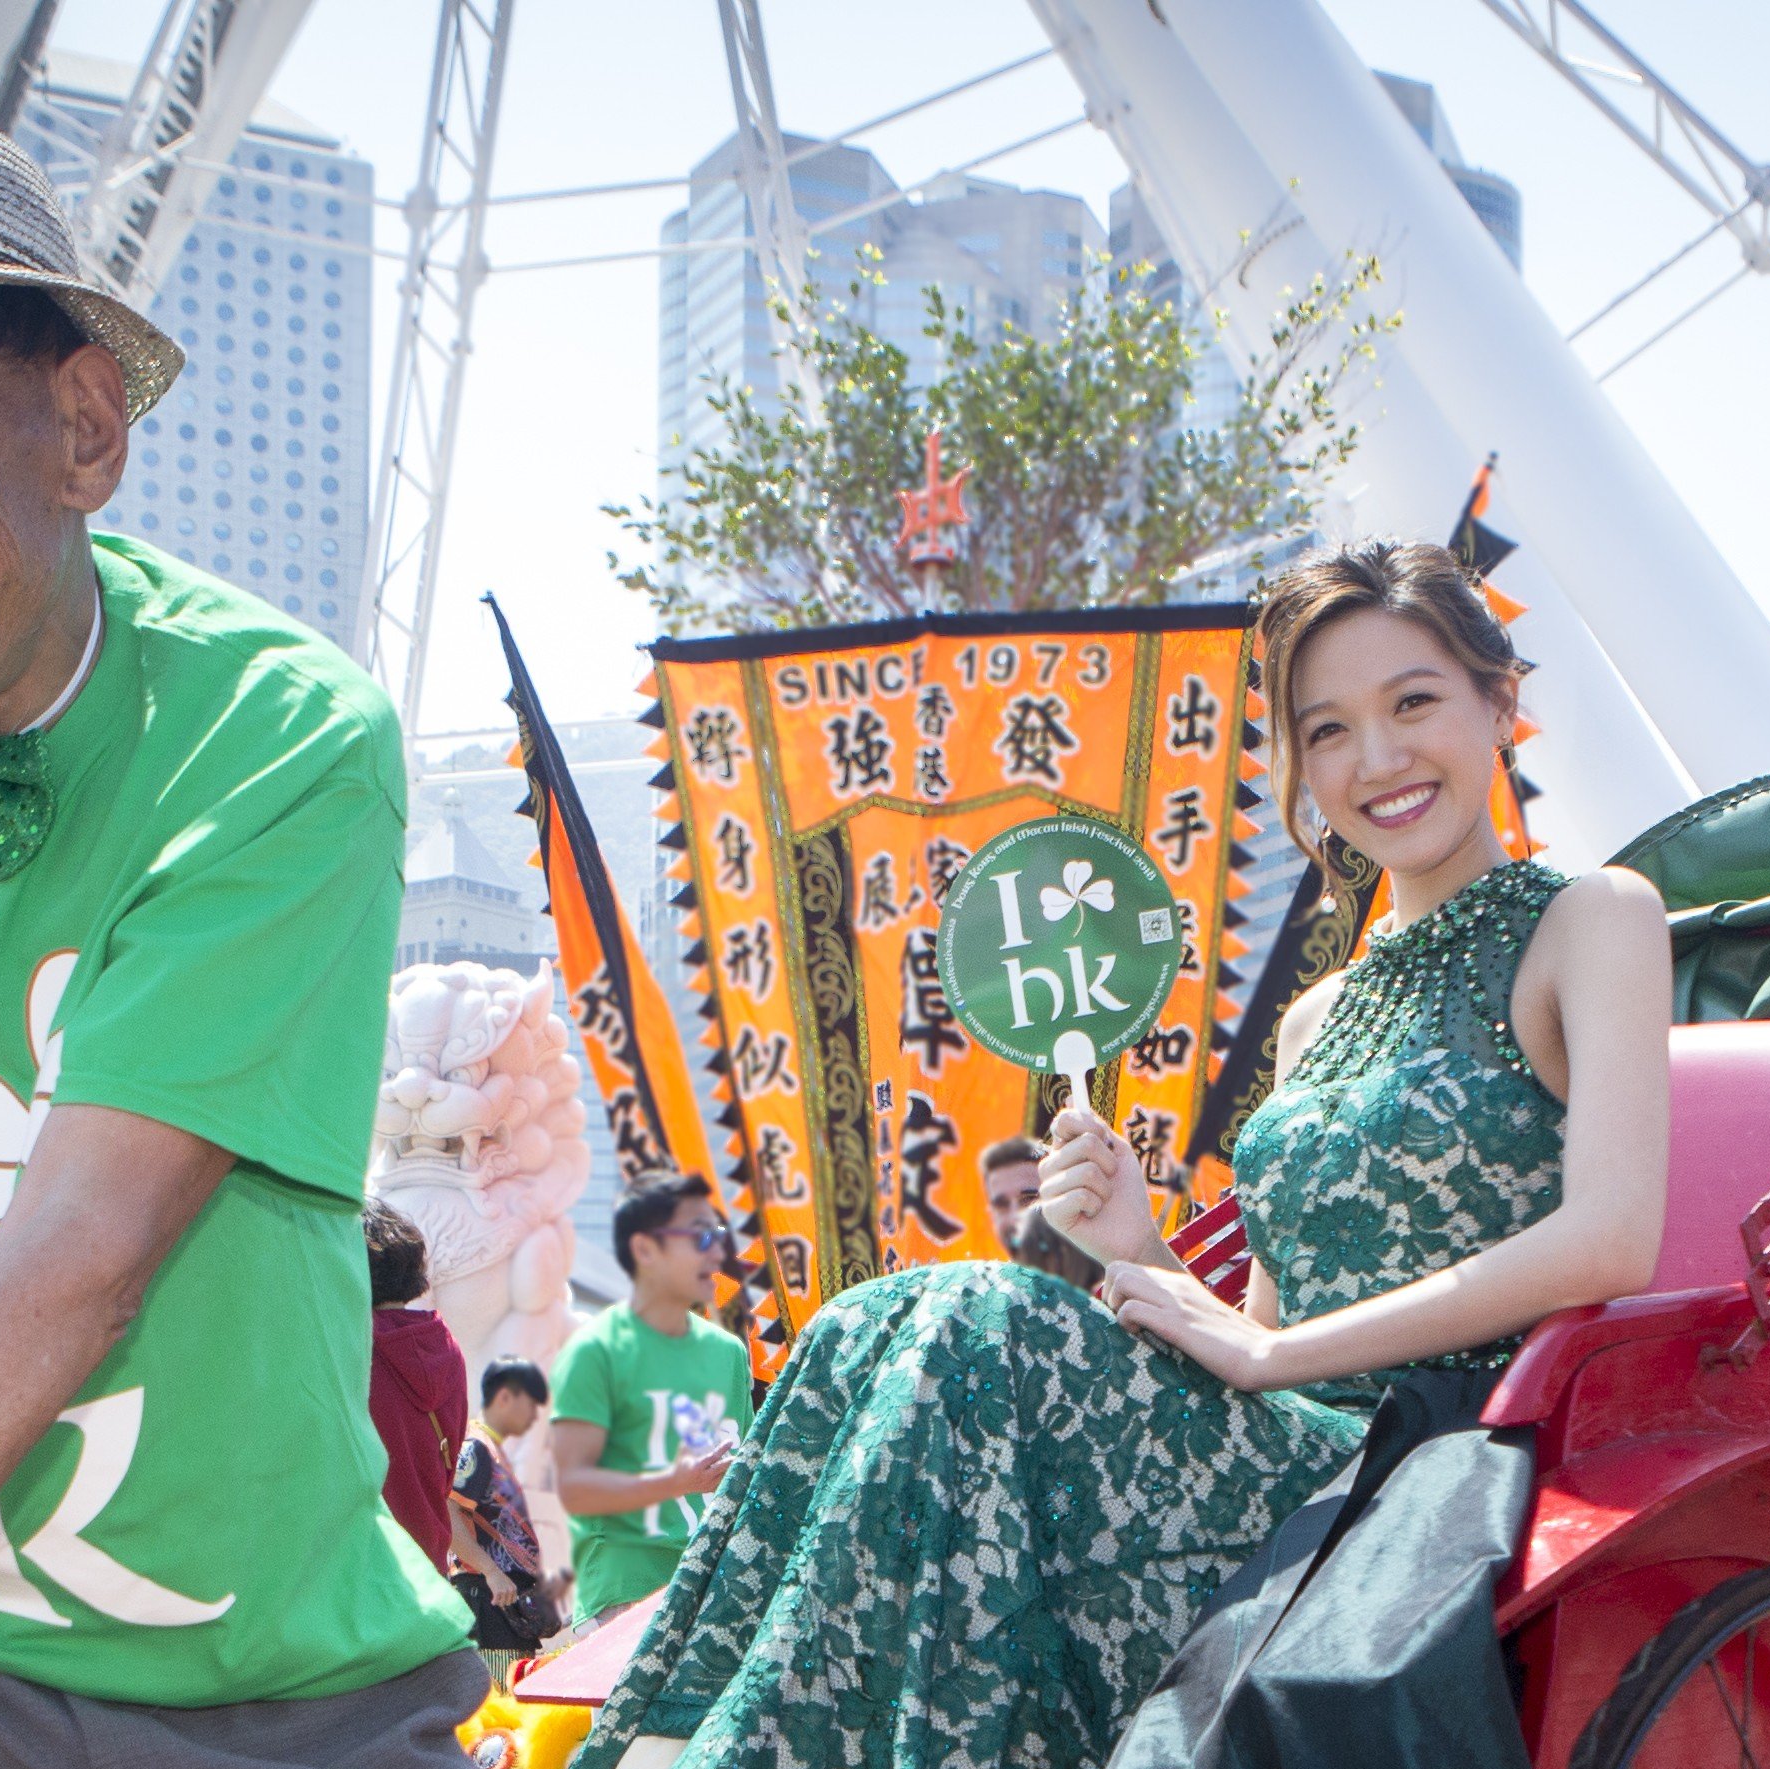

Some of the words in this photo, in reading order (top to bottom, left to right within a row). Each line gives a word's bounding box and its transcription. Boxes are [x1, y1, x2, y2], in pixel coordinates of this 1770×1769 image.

[957, 644, 1111, 685] 1973
[918, 686, 953, 797] 香港
[1060, 821, 1089, 837] Irish
[1090, 825, 1137, 858] Festival
[988, 869, 1033, 951] I
[1000, 945, 1132, 1030] hk
